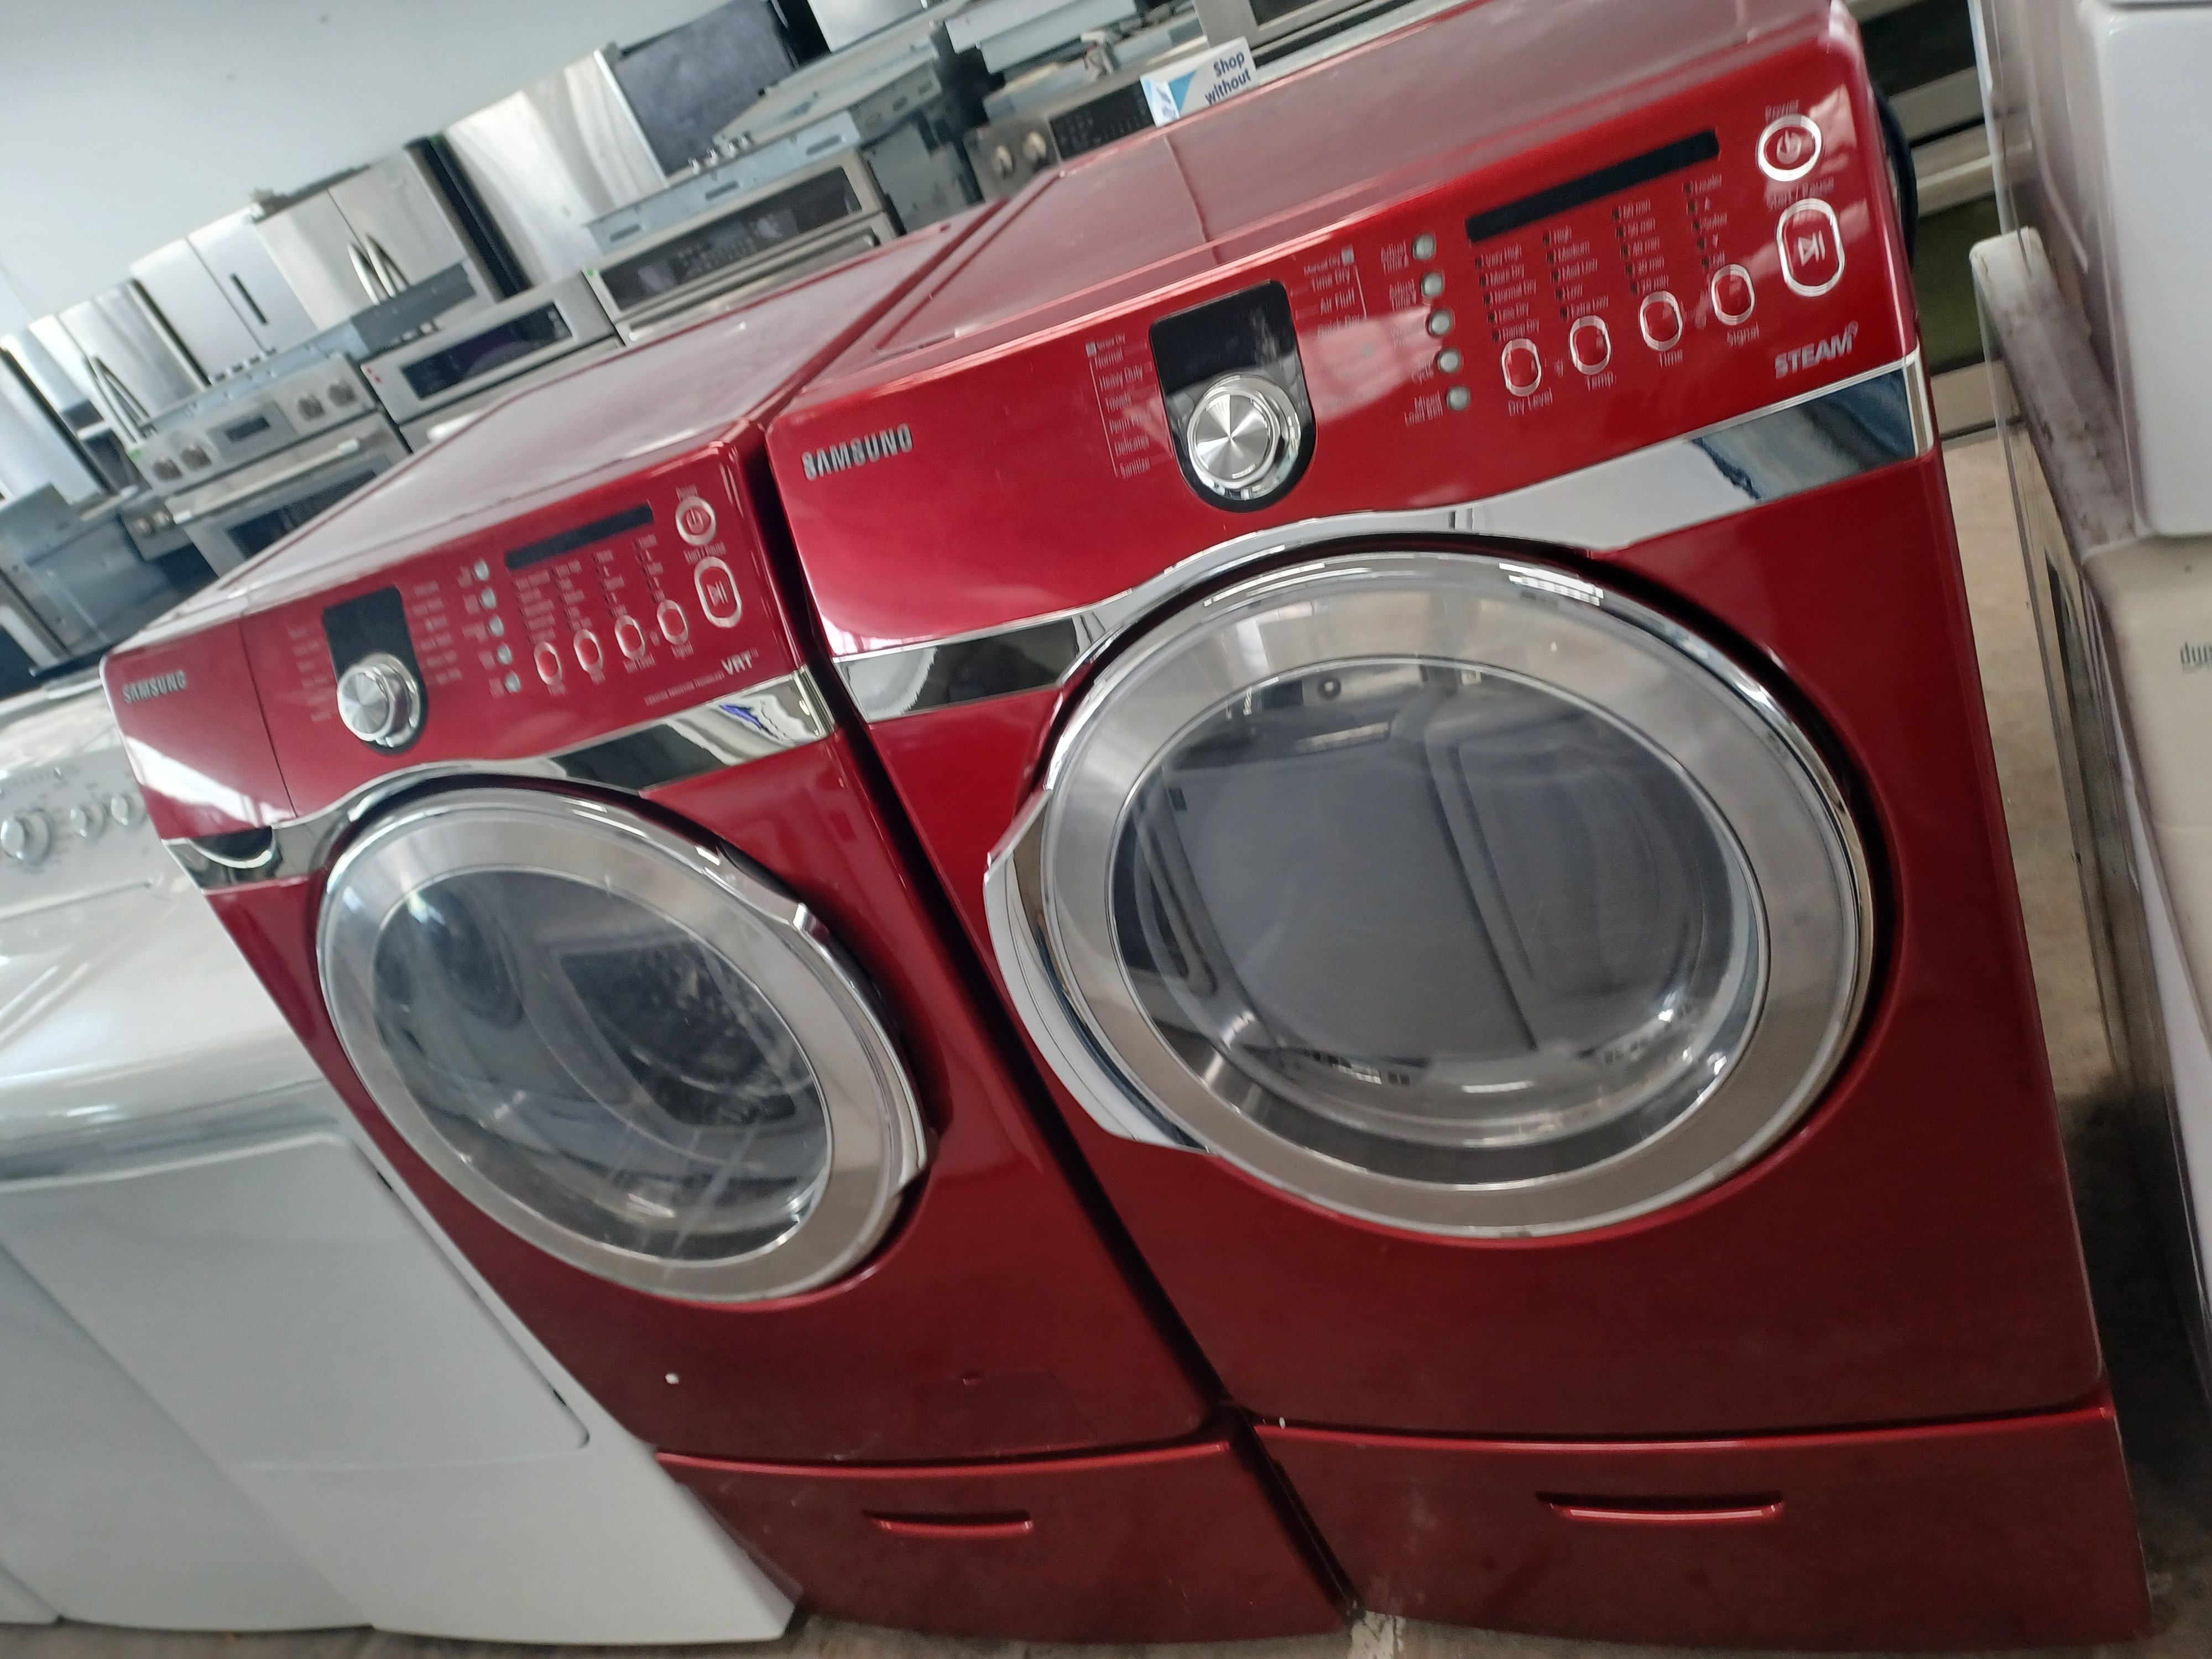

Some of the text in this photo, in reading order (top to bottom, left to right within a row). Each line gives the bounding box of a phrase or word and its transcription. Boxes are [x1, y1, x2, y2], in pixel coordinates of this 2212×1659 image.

[1213, 52, 1245, 77] Shop
[1204, 69, 1251, 106] without
[1775, 331, 1854, 379] STEAM
[802, 422, 914, 481] SAMSUNG
[123, 669, 187, 705] SAMSUNG
